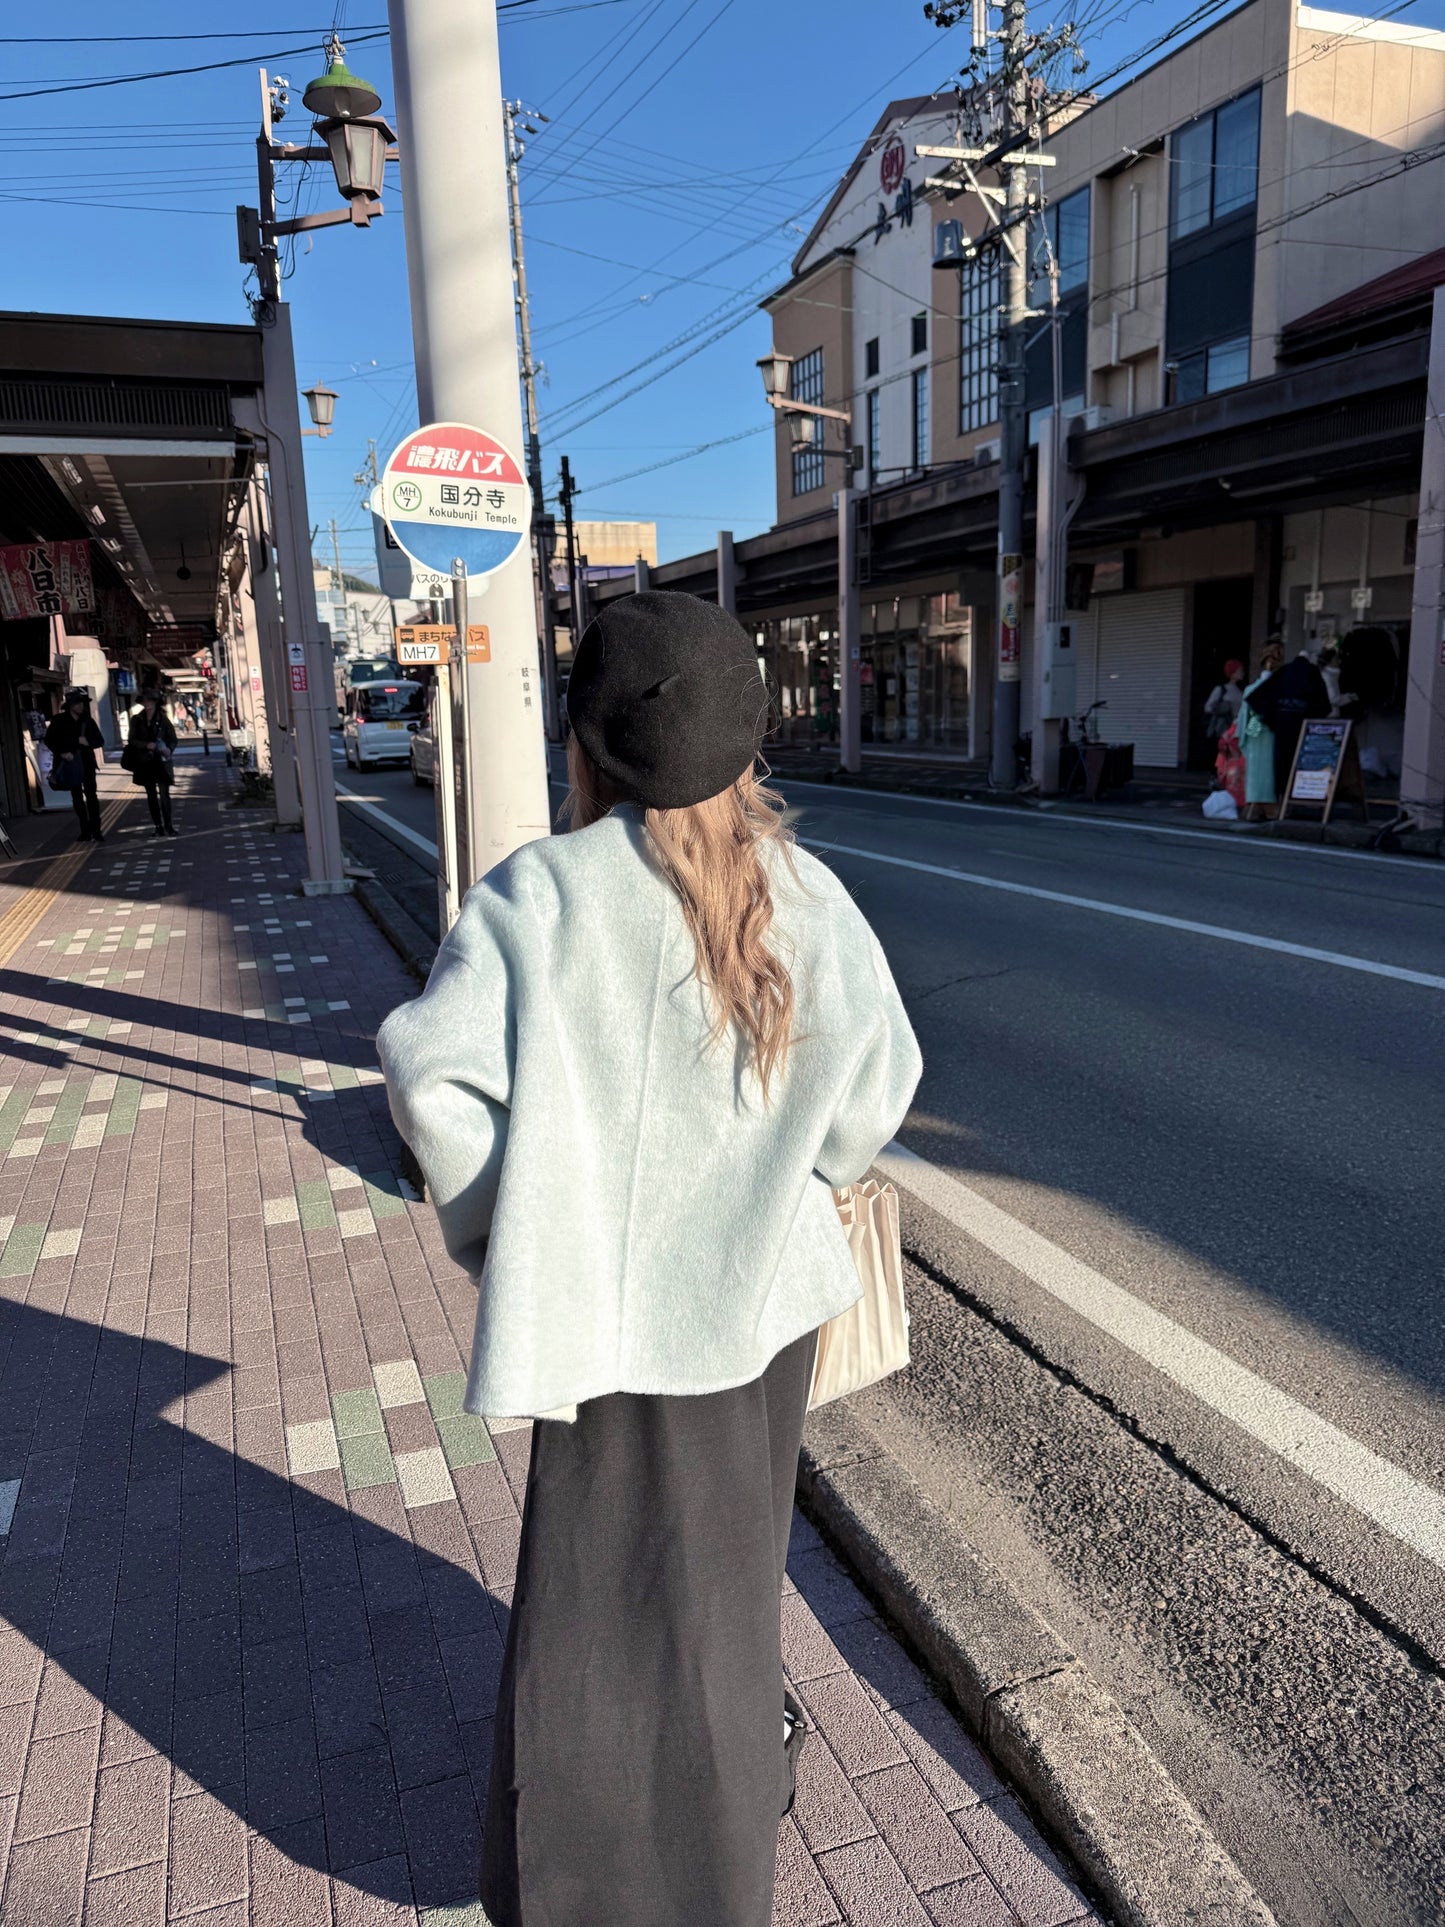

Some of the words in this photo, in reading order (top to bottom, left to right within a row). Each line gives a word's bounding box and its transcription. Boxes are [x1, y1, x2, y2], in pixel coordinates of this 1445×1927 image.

[406, 445, 506, 476] 濃飛バス
[398, 485, 416, 497] MH
[440, 484, 506, 509] 国分寺
[403, 497, 411, 508] 7
[429, 506, 478, 522] Kokubunji
[485, 511, 517, 525] Temple
[28, 548, 61, 613] 八日市
[403, 646, 438, 660] MH7
